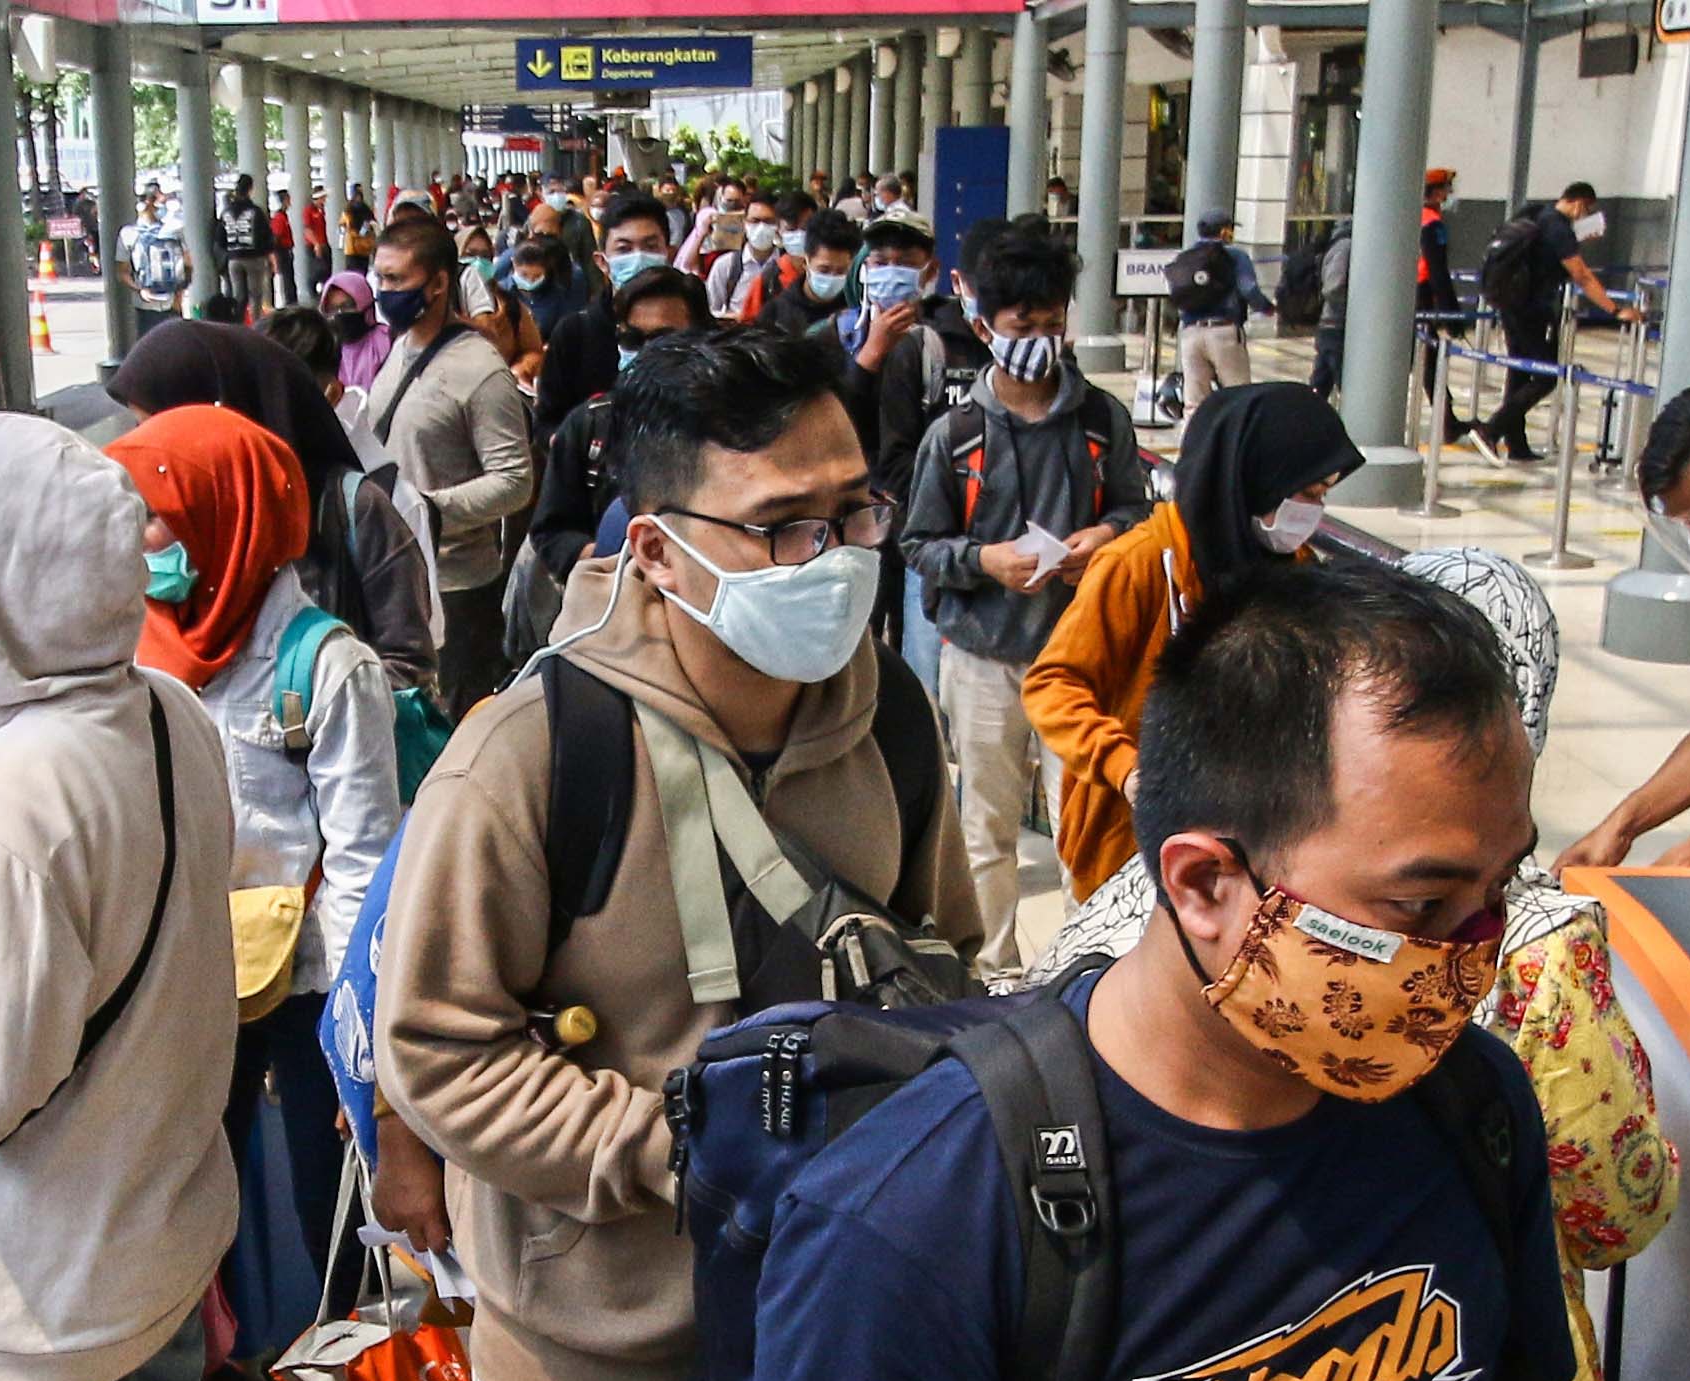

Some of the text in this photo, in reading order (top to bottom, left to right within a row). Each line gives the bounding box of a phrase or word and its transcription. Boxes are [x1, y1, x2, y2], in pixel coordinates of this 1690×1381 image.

[601, 47, 717, 66] Keberangkatan
[601, 68, 654, 79] Departures
[1307, 919, 1388, 954] saelook
